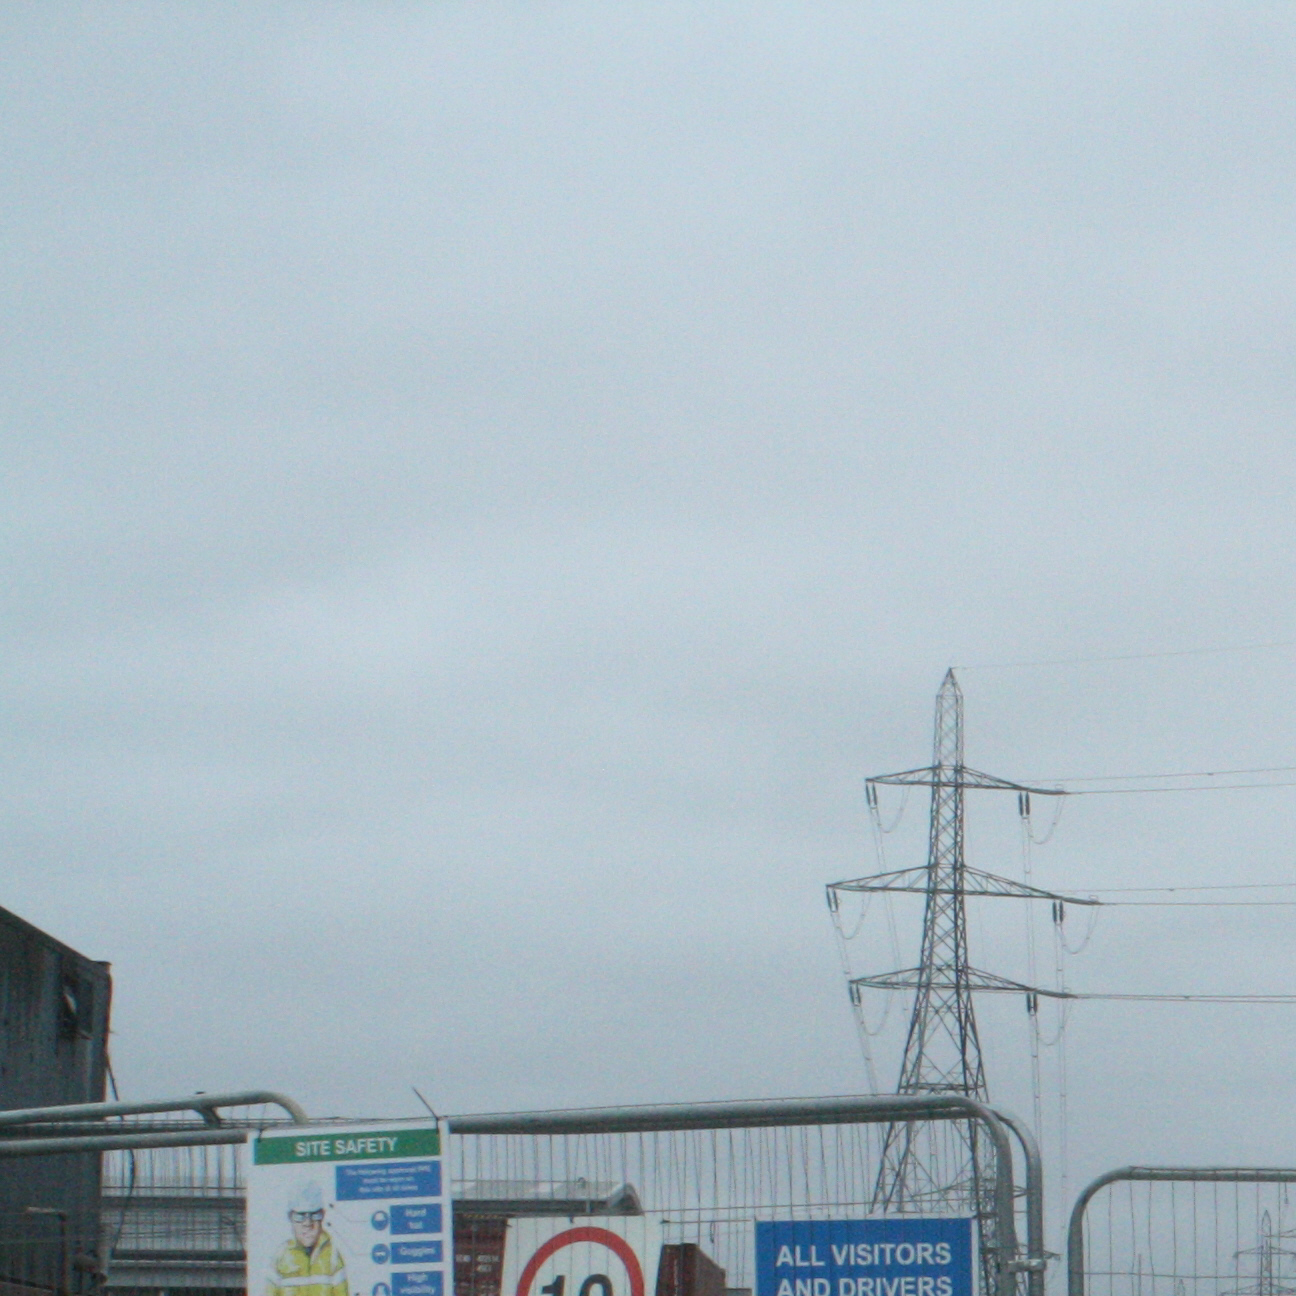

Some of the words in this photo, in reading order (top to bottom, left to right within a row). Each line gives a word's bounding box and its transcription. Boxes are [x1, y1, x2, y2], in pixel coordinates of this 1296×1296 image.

[295, 1141, 331, 1157] SITE
[335, 1136, 398, 1155] SAFETY
[776, 1245, 829, 1267] ALL
[832, 1242, 952, 1266] VISITORS
